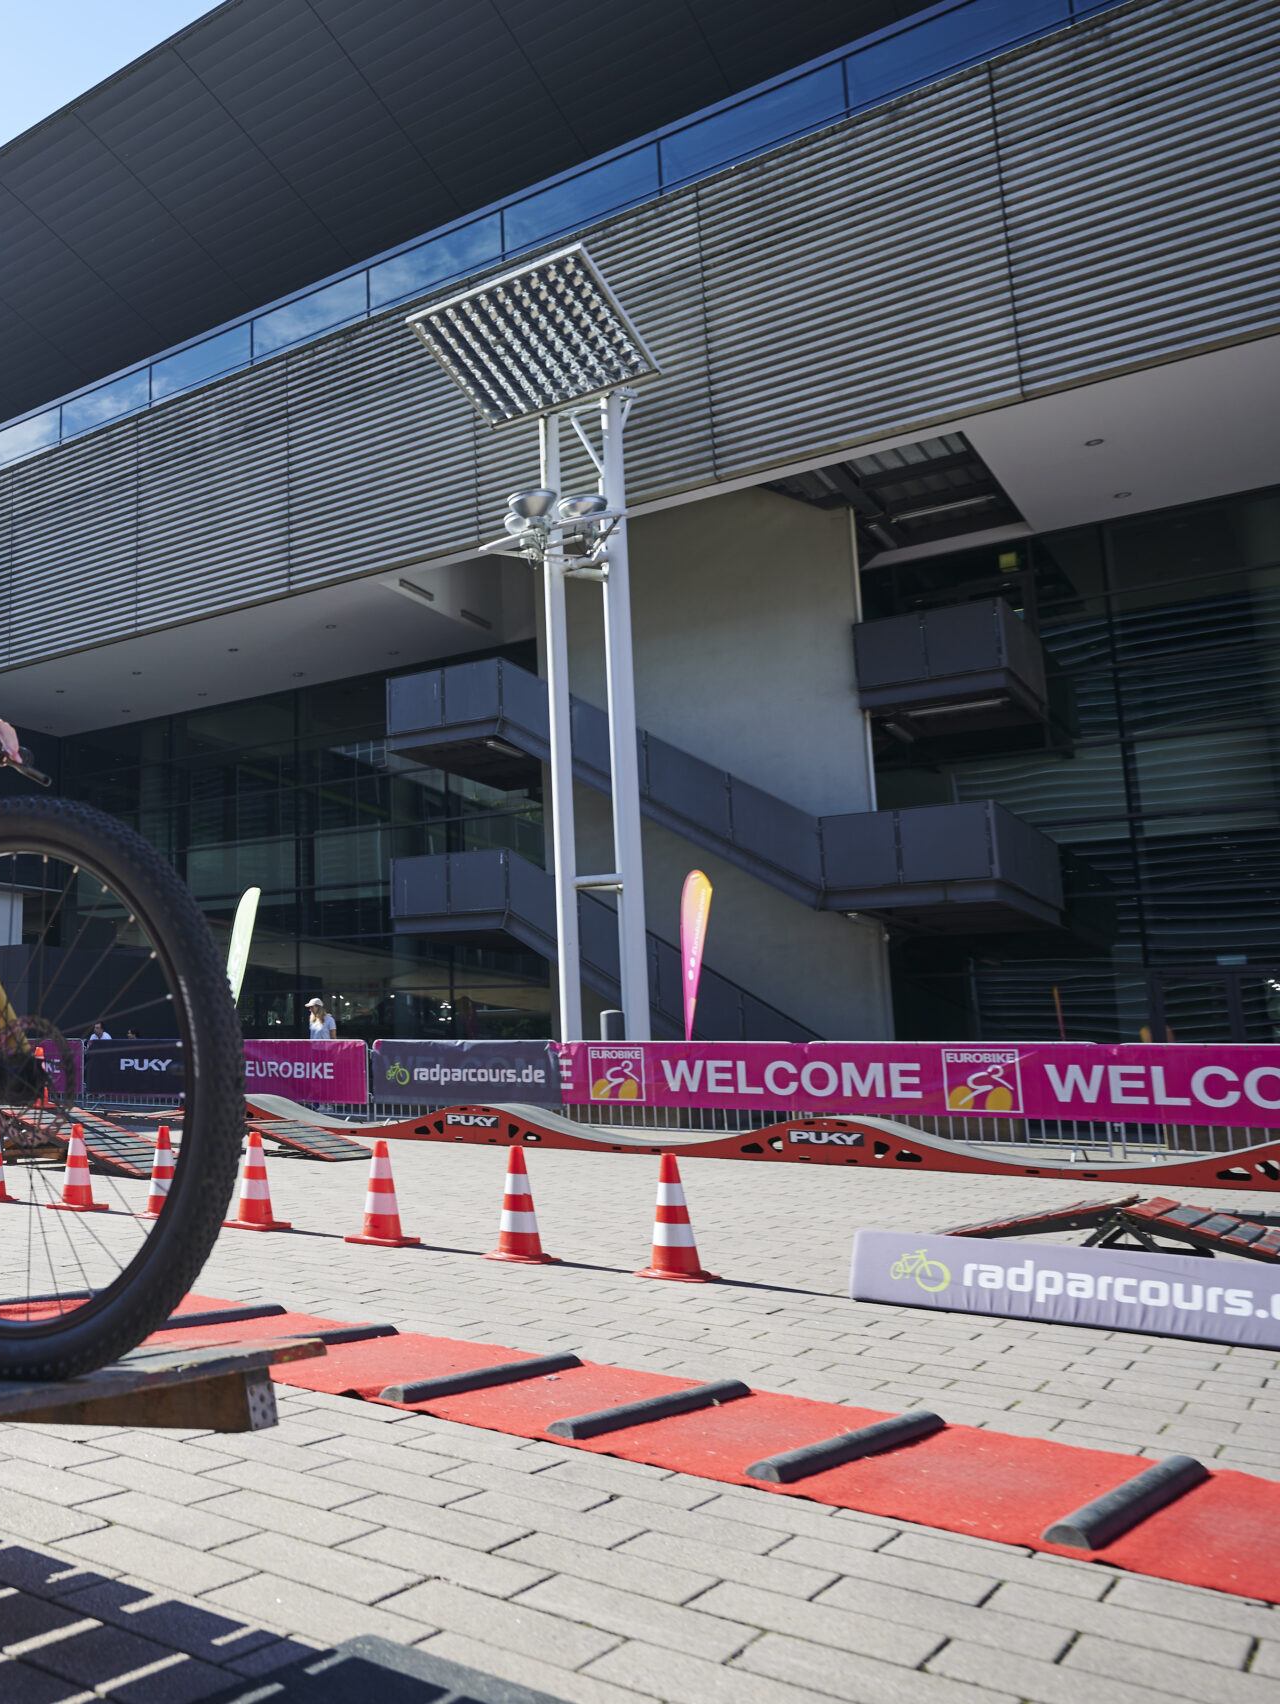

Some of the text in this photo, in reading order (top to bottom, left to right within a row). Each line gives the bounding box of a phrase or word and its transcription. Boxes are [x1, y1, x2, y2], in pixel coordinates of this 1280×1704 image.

[591, 1050, 642, 1059] EUROBIKE
[946, 1052, 1014, 1064] EUROBIKE
[120, 1058, 173, 1071] PUKY
[245, 1061, 335, 1079] EUROBIKE
[413, 1064, 546, 1085] radparcours.de
[661, 1060, 923, 1098] WELCOME
[447, 1114, 498, 1127] PUKY
[789, 1131, 862, 1146] PUKY
